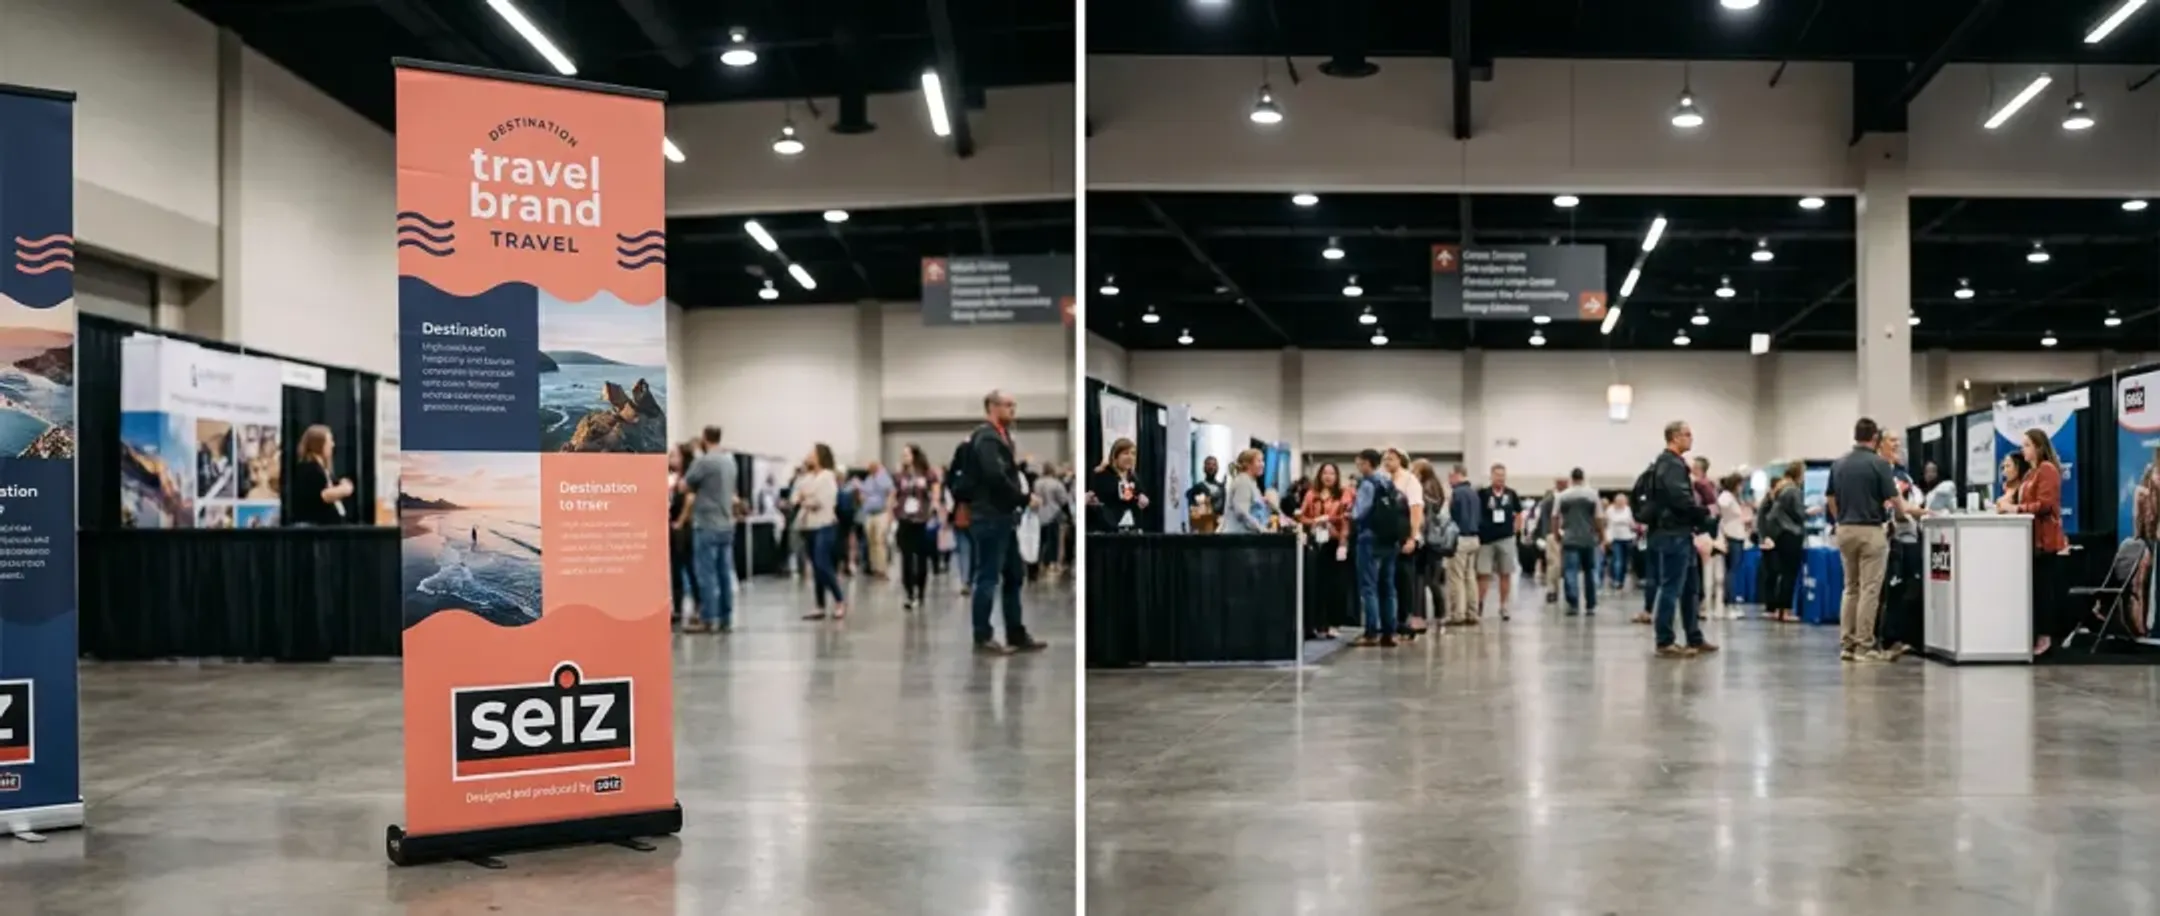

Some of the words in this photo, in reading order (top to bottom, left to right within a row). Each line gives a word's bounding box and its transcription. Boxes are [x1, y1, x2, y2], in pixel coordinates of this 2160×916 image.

[488, 117, 579, 148] DESTINATION
[470, 148, 599, 191] travel
[470, 182, 601, 227] brand
[490, 230, 579, 253] TRAVEL
[422, 321, 507, 338] Destination
[560, 480, 638, 494] Destination
[471, 670, 618, 751] seiz
[466, 788, 511, 803] Designed
[513, 787, 531, 799] and
